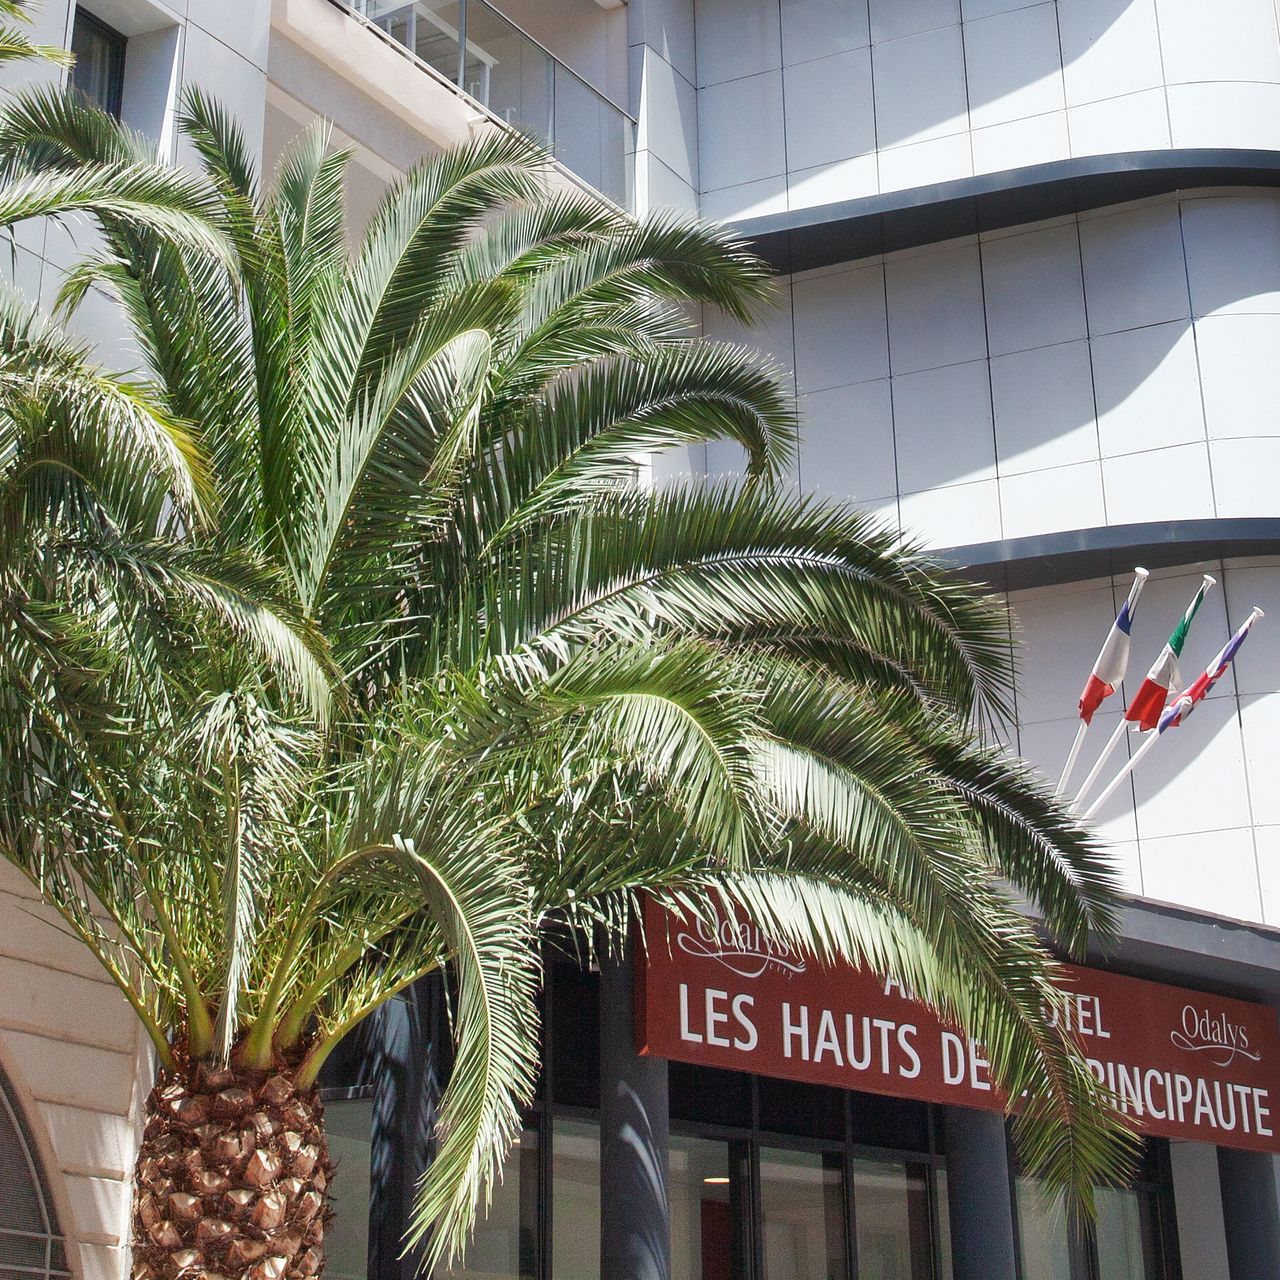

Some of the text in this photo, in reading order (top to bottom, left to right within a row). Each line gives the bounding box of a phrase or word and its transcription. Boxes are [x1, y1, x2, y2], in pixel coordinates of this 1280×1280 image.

[678, 983, 759, 1052] LES
[781, 1002, 921, 1079] HAUTS
[940, 1031, 992, 1091] DE
[1181, 1004, 1250, 1067] Odalys
